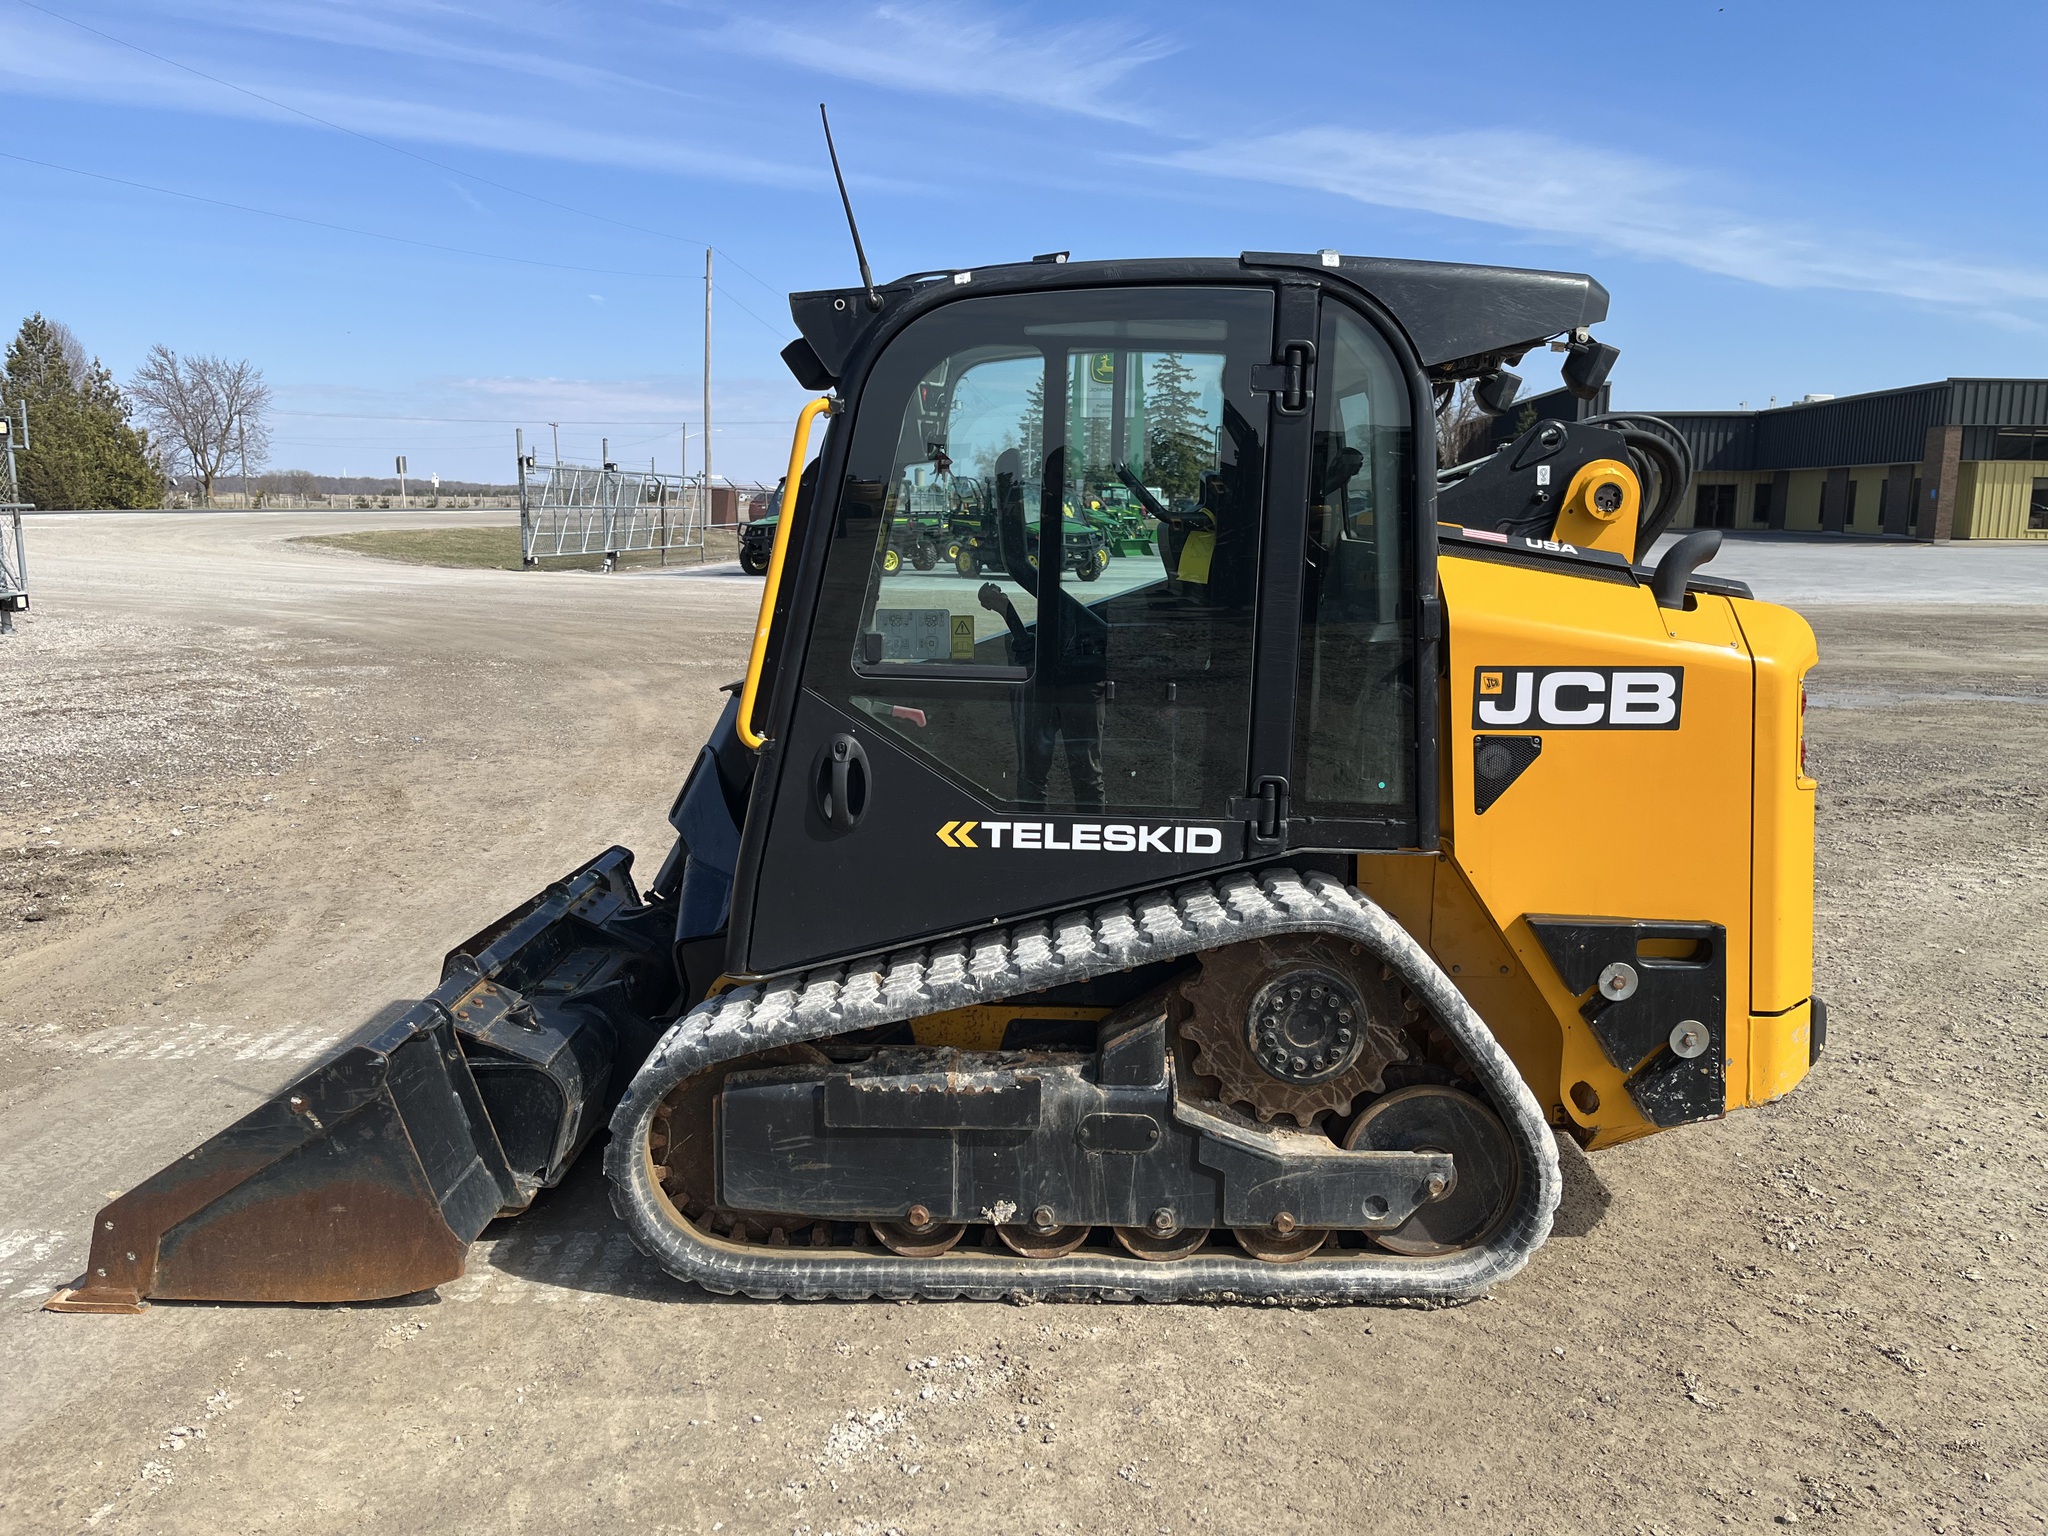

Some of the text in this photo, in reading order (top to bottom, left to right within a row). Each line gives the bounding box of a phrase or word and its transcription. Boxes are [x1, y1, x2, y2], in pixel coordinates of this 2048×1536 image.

[1525, 537, 1579, 555] USA
[1478, 671, 1677, 725] JCB
[980, 820, 1223, 855] TELESKID
